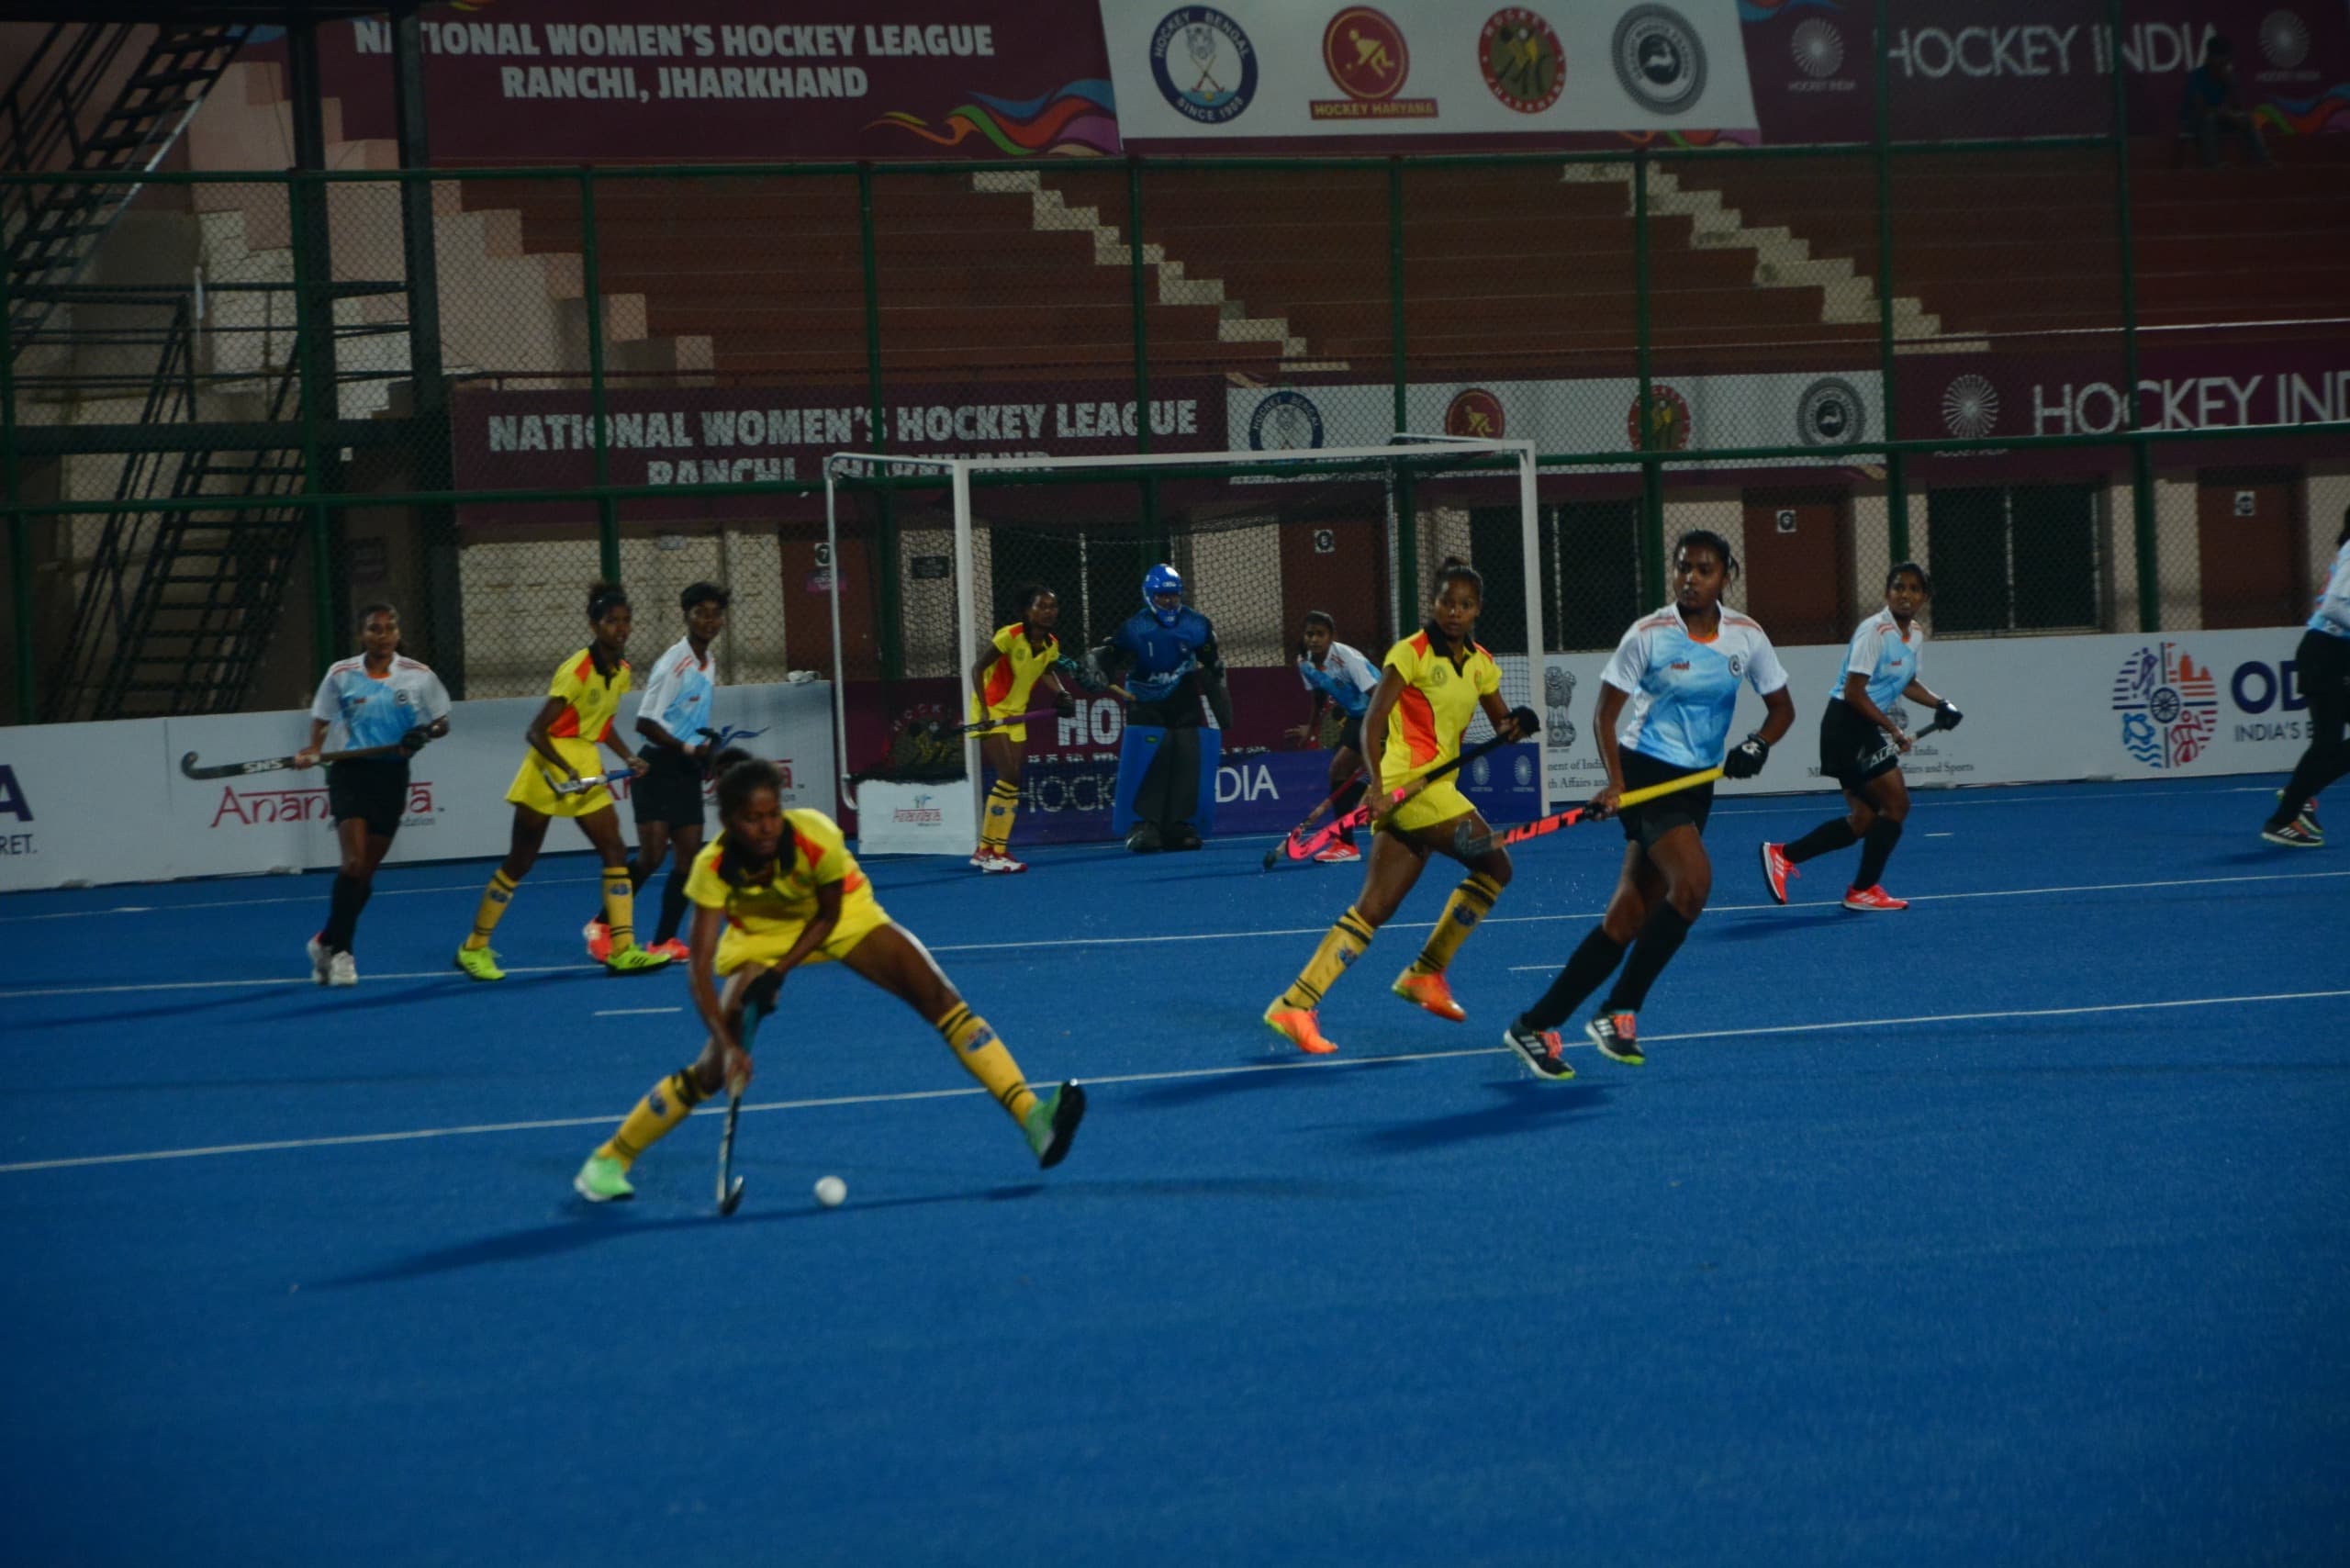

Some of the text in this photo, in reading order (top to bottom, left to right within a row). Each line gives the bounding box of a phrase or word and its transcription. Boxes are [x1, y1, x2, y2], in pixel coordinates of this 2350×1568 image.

[353, 22, 995, 57] NTIONAL WOMEN'S HOCKEY LEAGUE
[500, 66, 868, 103] RANCHI, JHARKHAND
[1314, 102, 1433, 117] HOCKEY HARYANA
[2032, 374, 2264, 435] HOCKEY
[488, 412, 693, 452] NATIONAL
[896, 404, 1046, 442] HOCKEY
[1056, 399, 1197, 438] LEAGUE
[2234, 721, 2301, 742] INDIA'S
[1214, 764, 1280, 803] DIA
